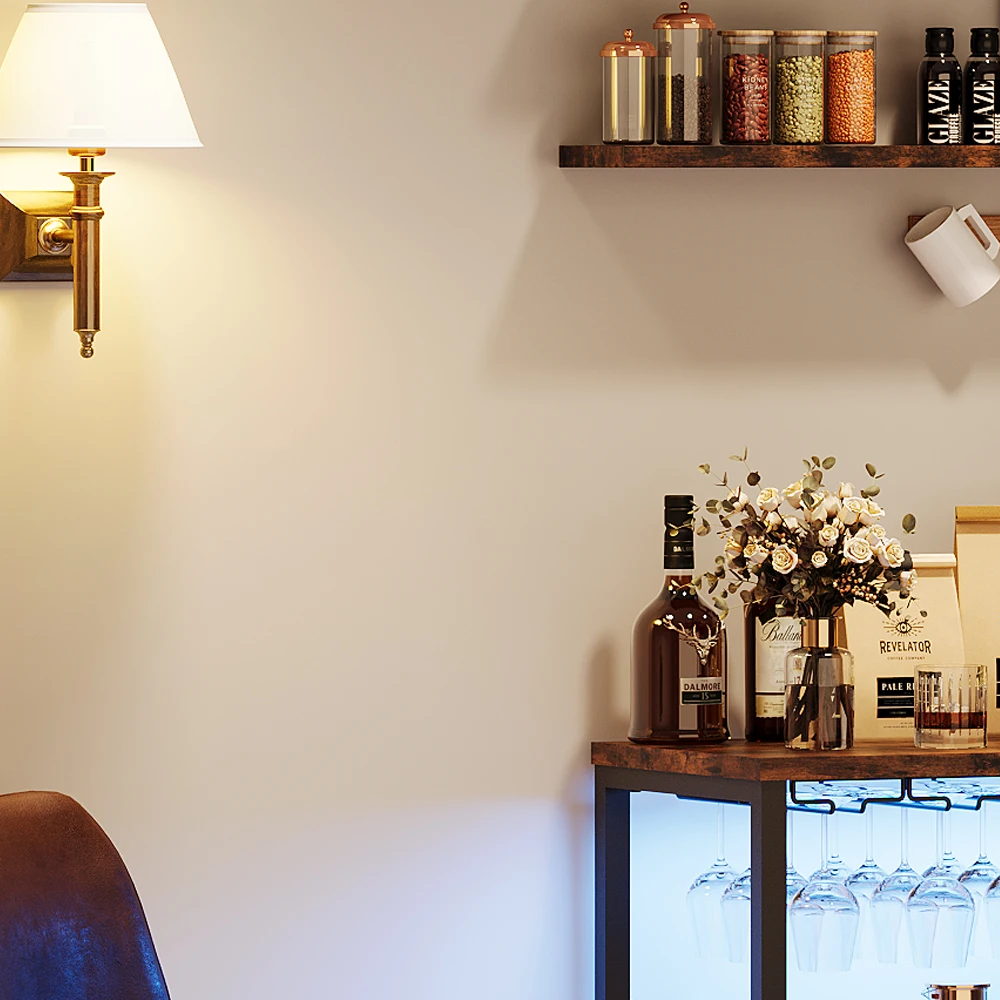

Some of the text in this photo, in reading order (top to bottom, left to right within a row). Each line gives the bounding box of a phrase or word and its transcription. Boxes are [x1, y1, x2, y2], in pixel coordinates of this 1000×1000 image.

[927, 80, 950, 144] GLAZE
[973, 80, 995, 144] GLAZE
[949, 113, 960, 144] TRUFFLE
[879, 640, 932, 655] REVELATOR
[684, 683, 721, 691] DALMORE
[881, 683, 904, 691] PALE
